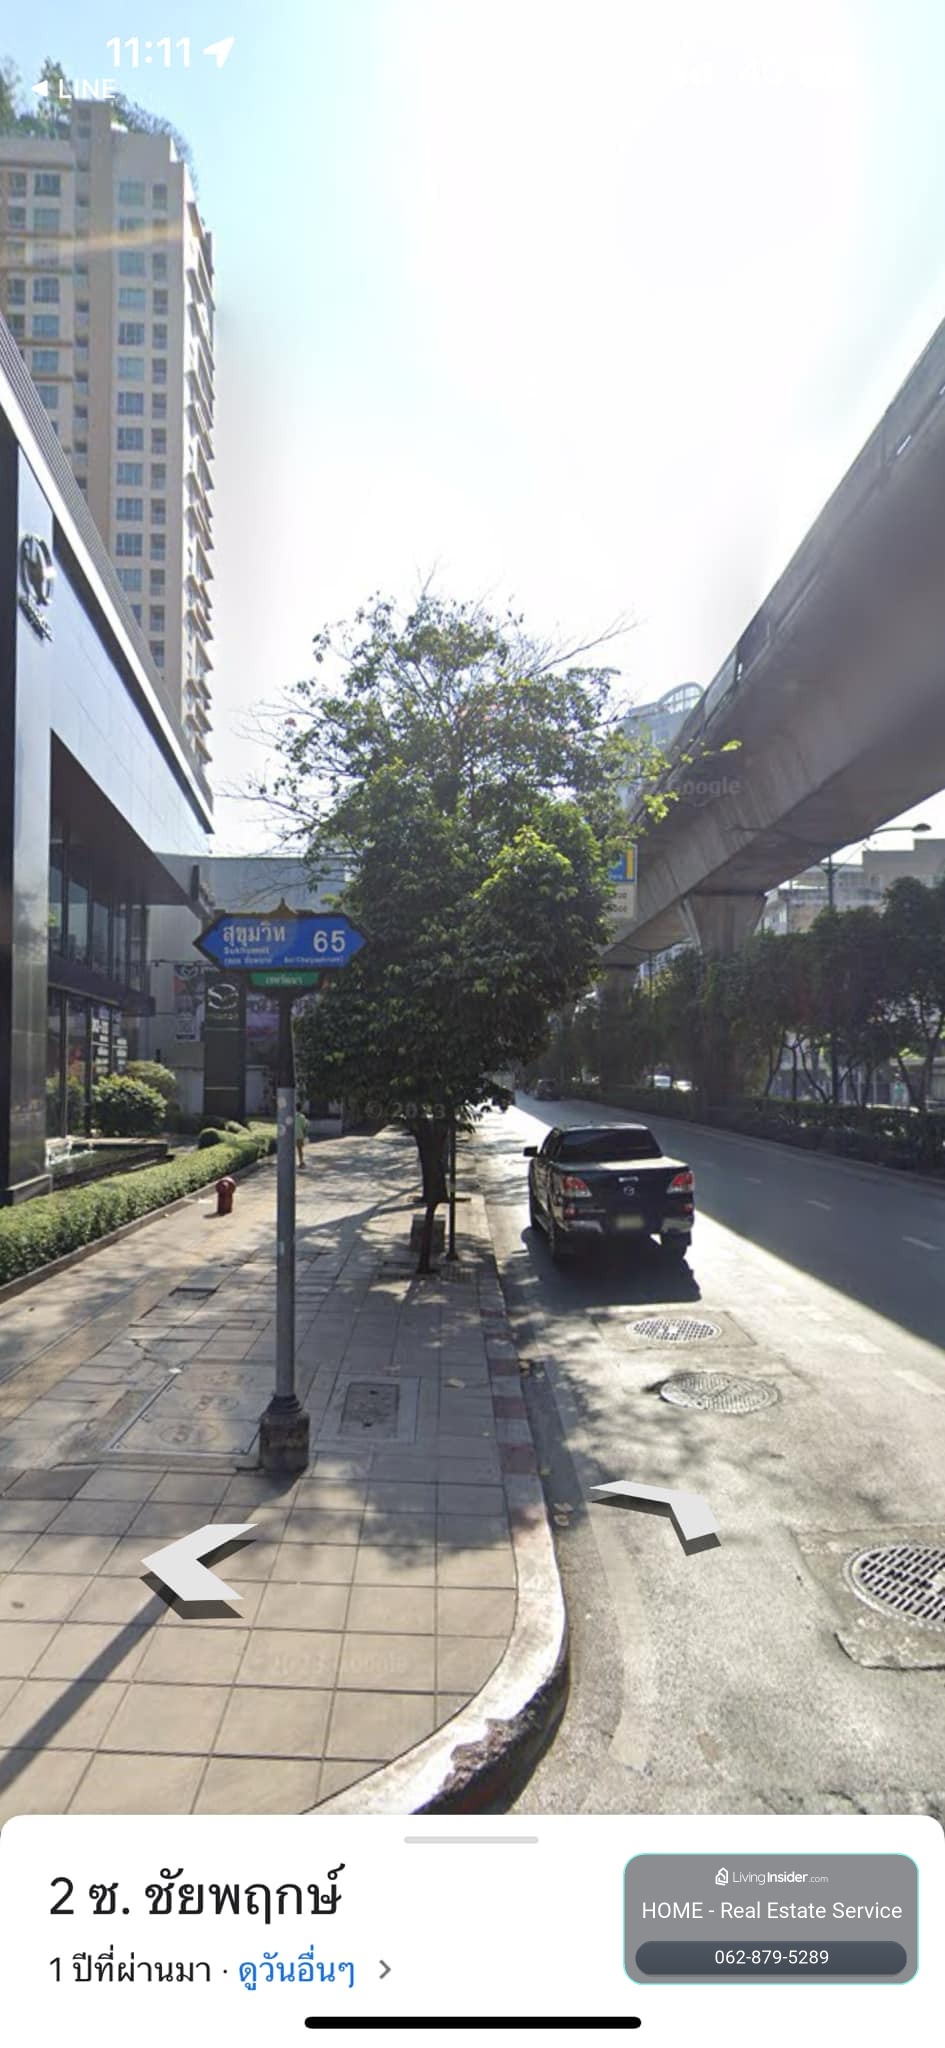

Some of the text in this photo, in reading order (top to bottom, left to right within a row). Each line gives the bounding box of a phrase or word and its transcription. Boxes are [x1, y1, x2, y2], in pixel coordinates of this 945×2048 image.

[223, 921, 346, 953] สุขุมวิท 65
